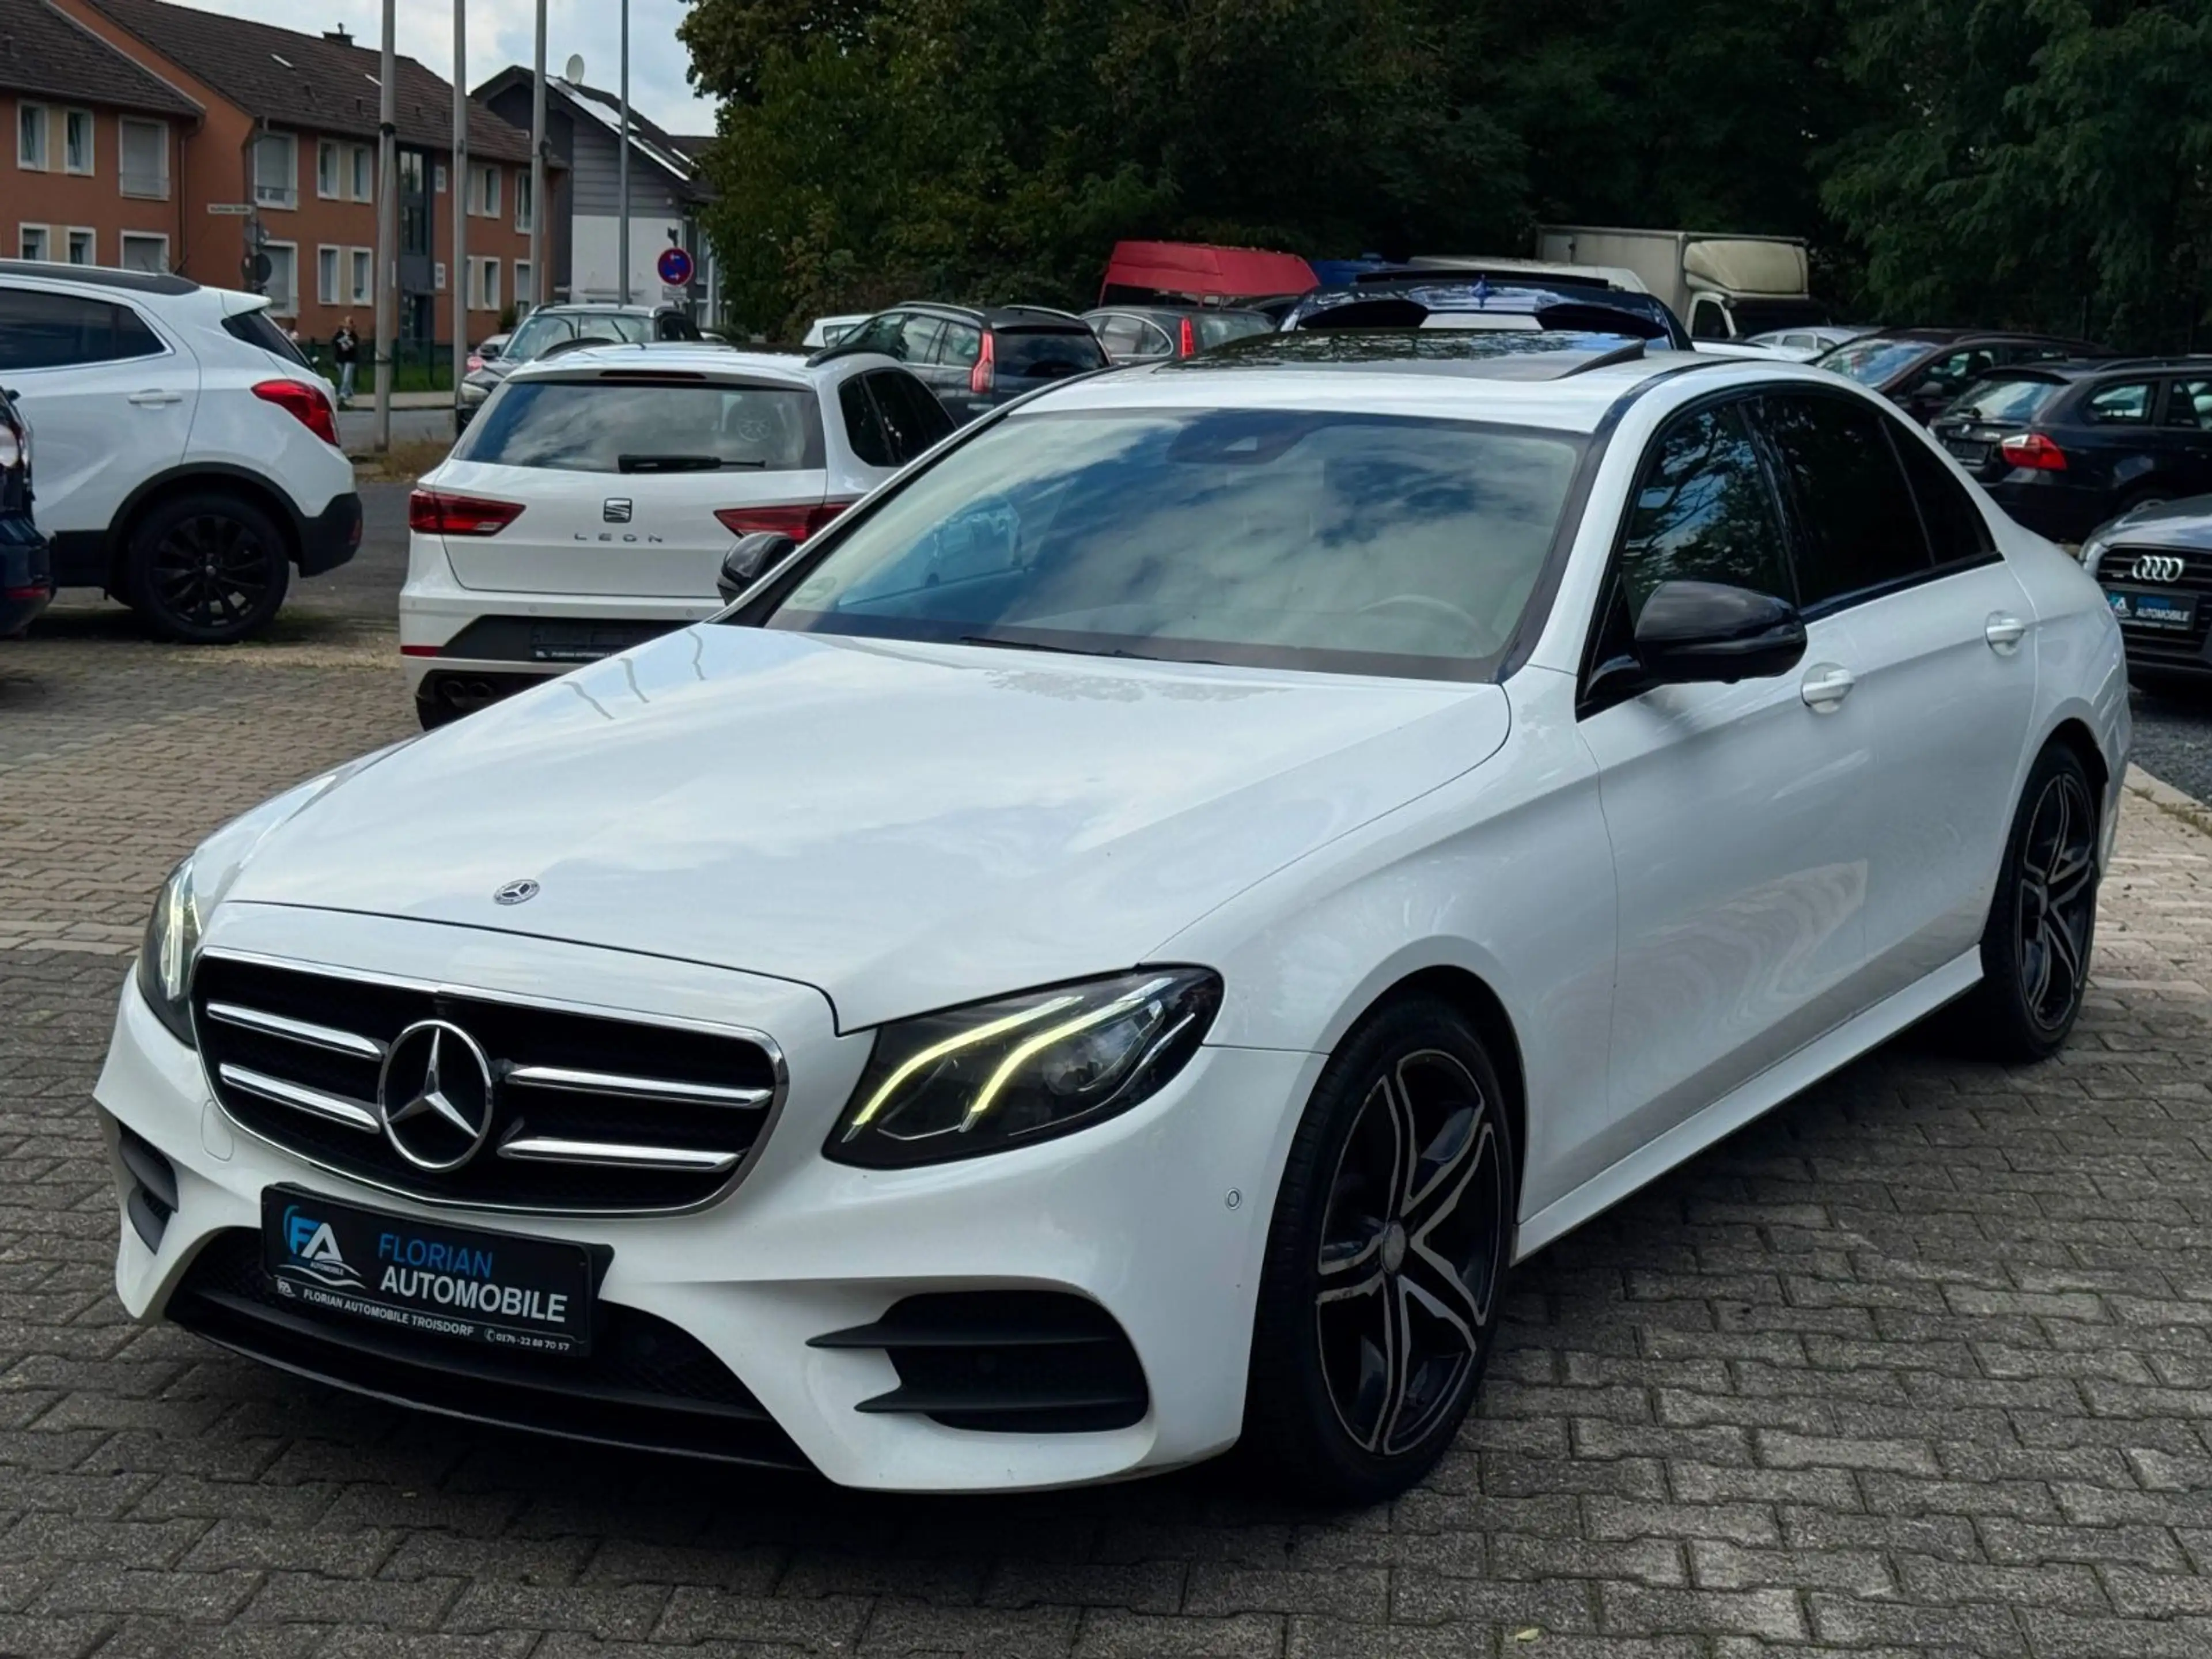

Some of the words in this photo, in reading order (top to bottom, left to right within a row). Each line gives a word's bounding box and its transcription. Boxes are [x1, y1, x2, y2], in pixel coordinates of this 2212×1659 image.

[574, 532, 663, 543] LEON
[378, 1232, 493, 1278] FLORIAN
[304, 1289, 343, 1309] FLORIAN
[344, 1300, 409, 1324] AUTOMOBILE
[412, 1314, 475, 1336] TROISDORF
[380, 1265, 568, 1323] AUTOMOBILE
[544, 1340, 557, 1349] 70
[558, 1342, 570, 1351] 57
